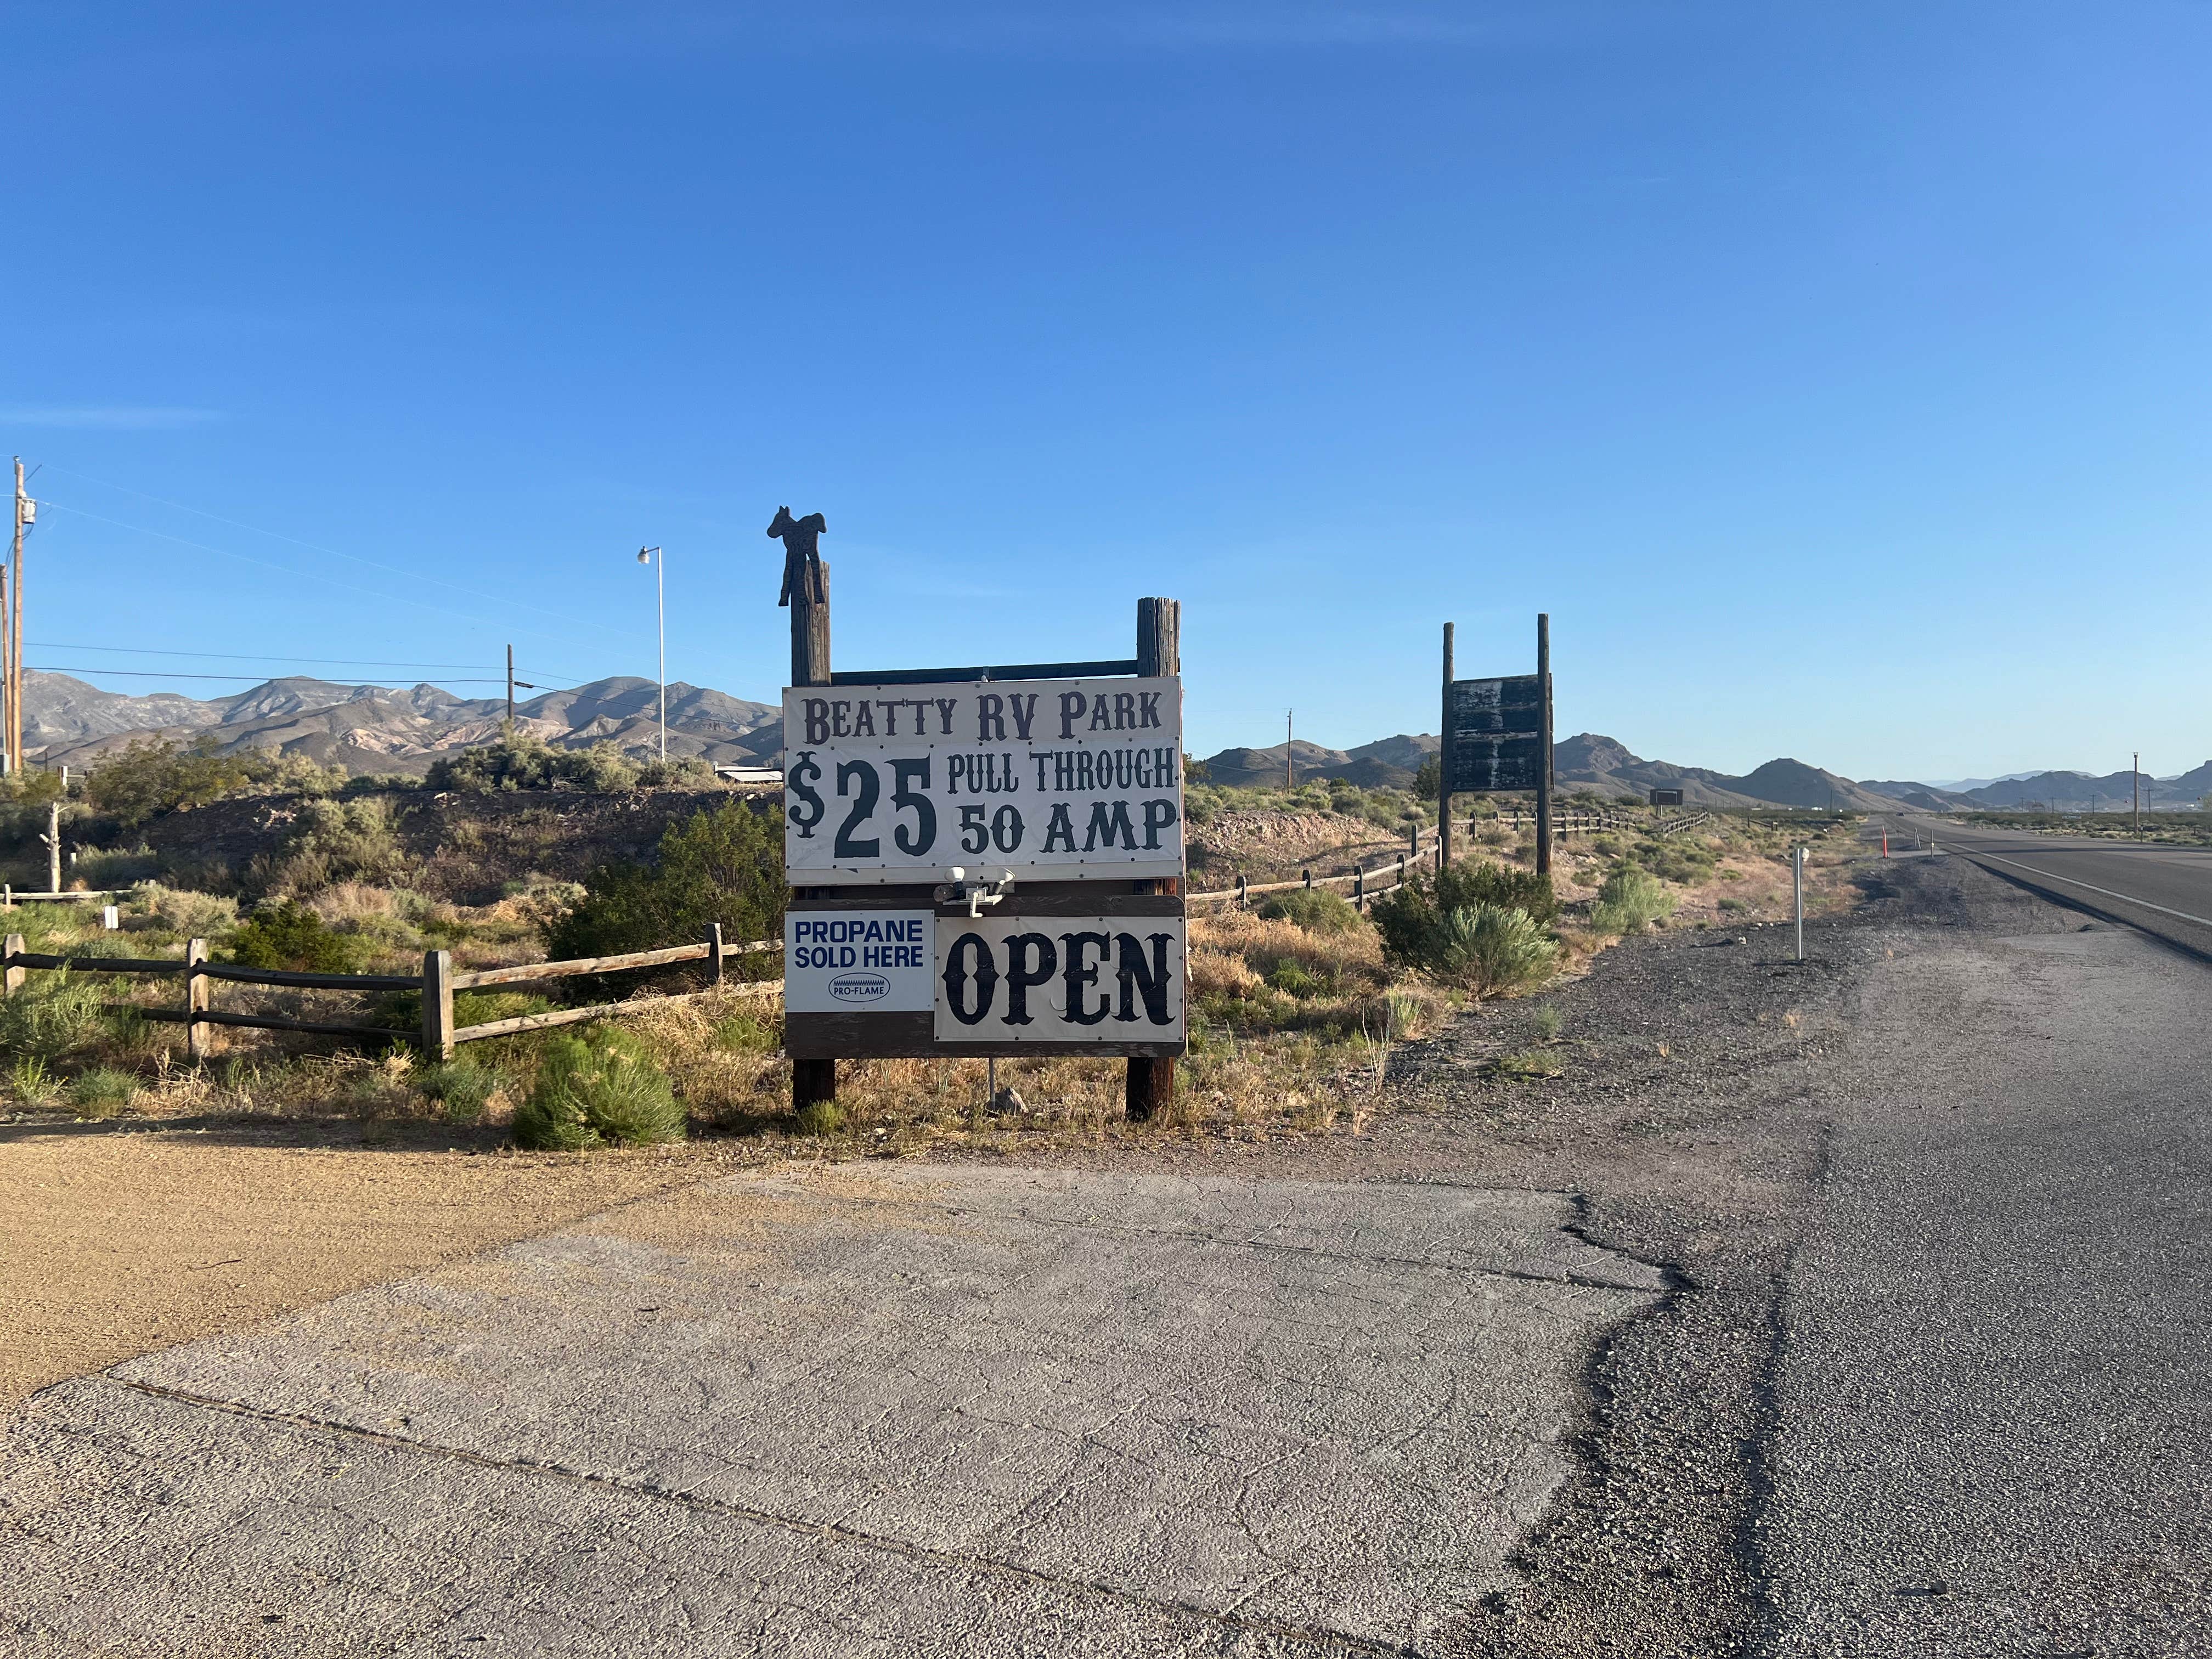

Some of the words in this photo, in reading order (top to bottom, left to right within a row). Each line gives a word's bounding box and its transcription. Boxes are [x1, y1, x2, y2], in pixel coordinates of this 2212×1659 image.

[800, 698, 957, 745] BEATTY
[976, 693, 1039, 741] RV
[1057, 691, 1162, 740] PARK
[947, 753, 1019, 794] PULL
[1029, 747, 1176, 792] THROUGH
[788, 751, 937, 858] $25
[957, 803, 1026, 854] 50
[1039, 799, 1177, 854] AMP
[795, 919, 923, 943] PROPANE
[795, 946, 856, 968] SOLD
[864, 945, 923, 967] HERE
[941, 931, 1176, 1026] OPEN
[834, 986, 884, 995] PRO-FLAME
